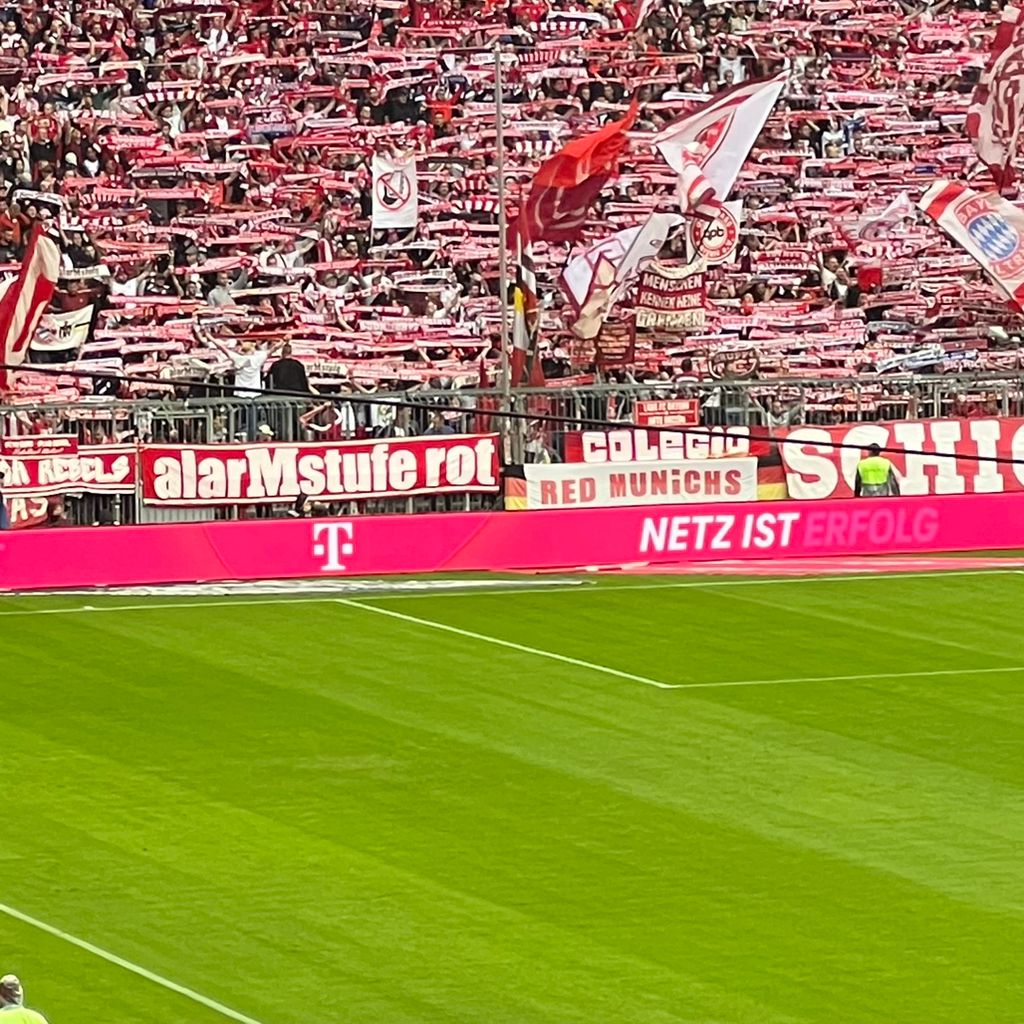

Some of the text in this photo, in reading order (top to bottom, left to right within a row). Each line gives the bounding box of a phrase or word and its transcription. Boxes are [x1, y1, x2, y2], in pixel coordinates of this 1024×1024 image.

[153, 439, 496, 500] alarMstufe rot
[540, 476, 597, 505] RED
[639, 507, 939, 552] NETZ IST ERFOLG
